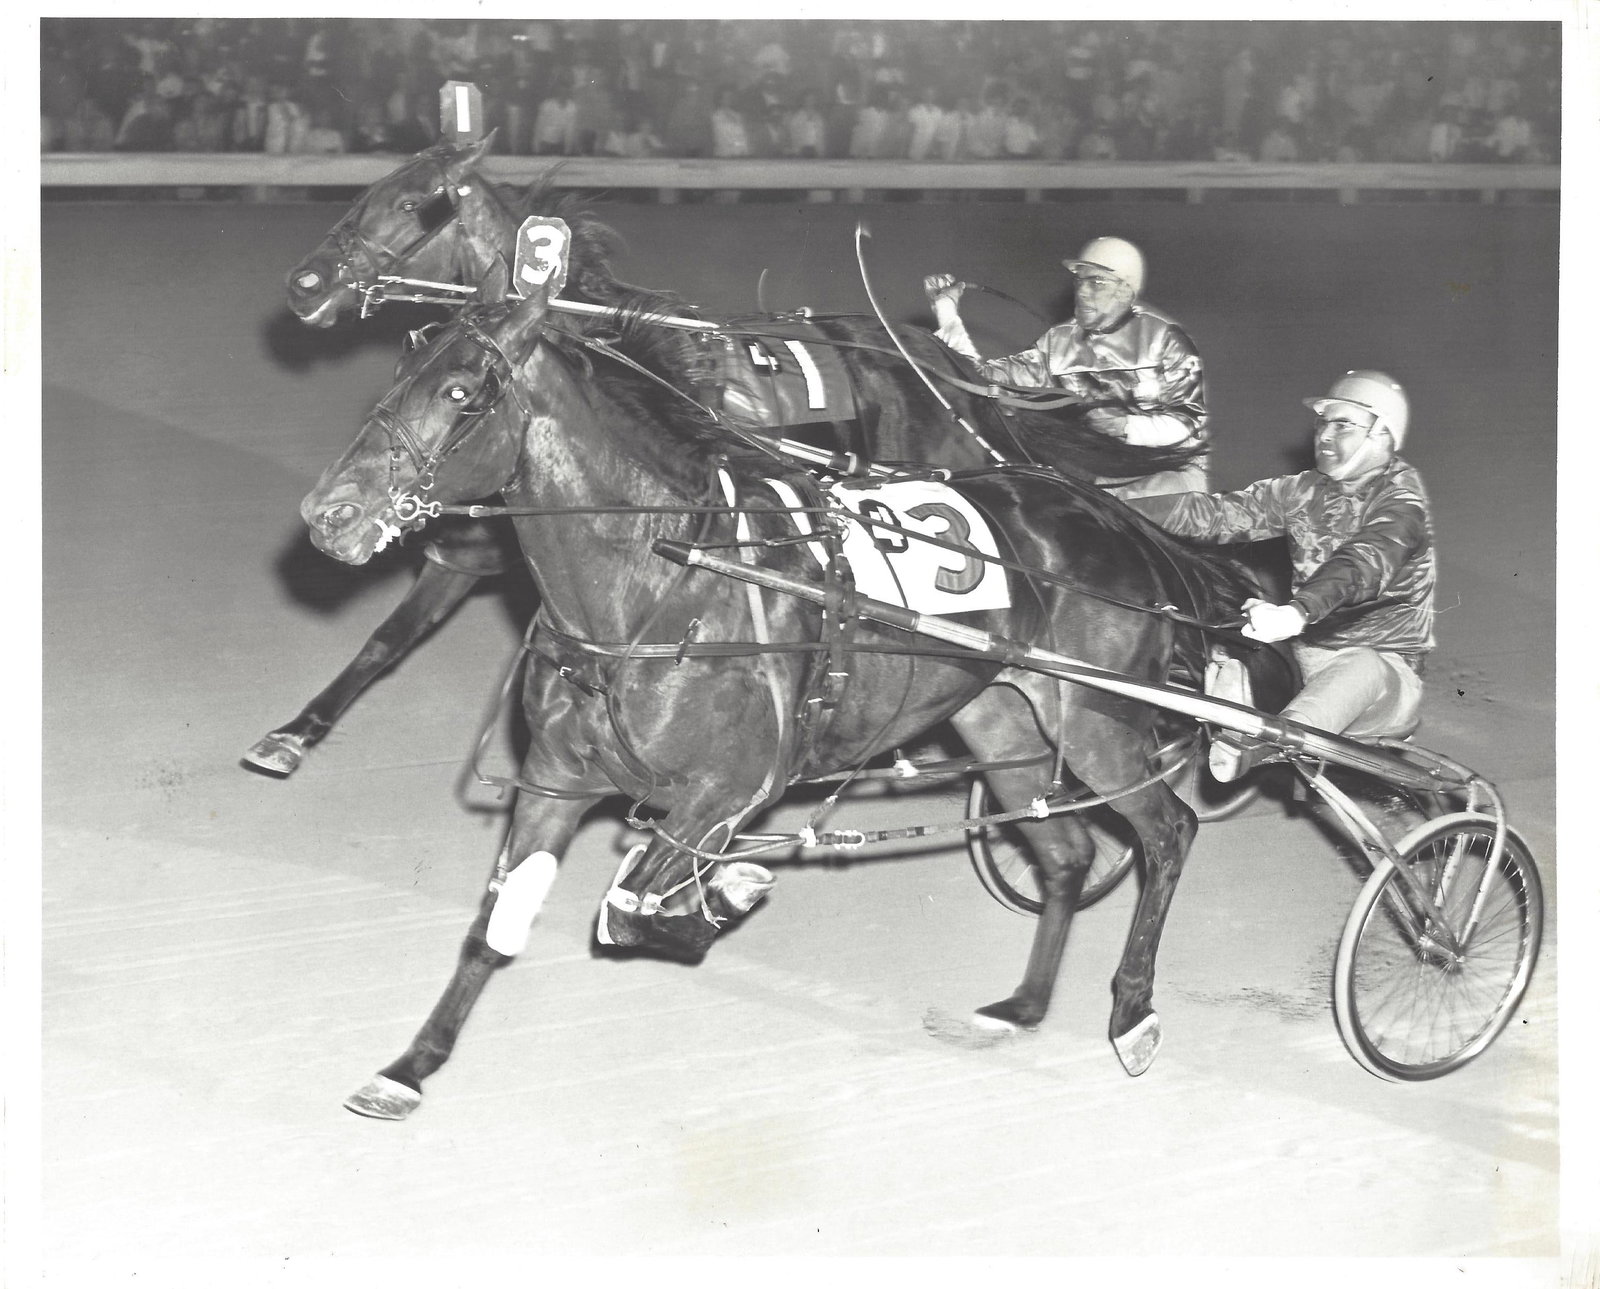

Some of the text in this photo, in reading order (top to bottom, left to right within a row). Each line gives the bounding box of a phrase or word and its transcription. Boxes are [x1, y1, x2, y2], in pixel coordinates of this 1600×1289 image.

[455, 86, 471, 132] 1
[521, 225, 567, 284] 3
[783, 340, 826, 409] 1
[904, 502, 986, 594] 3
